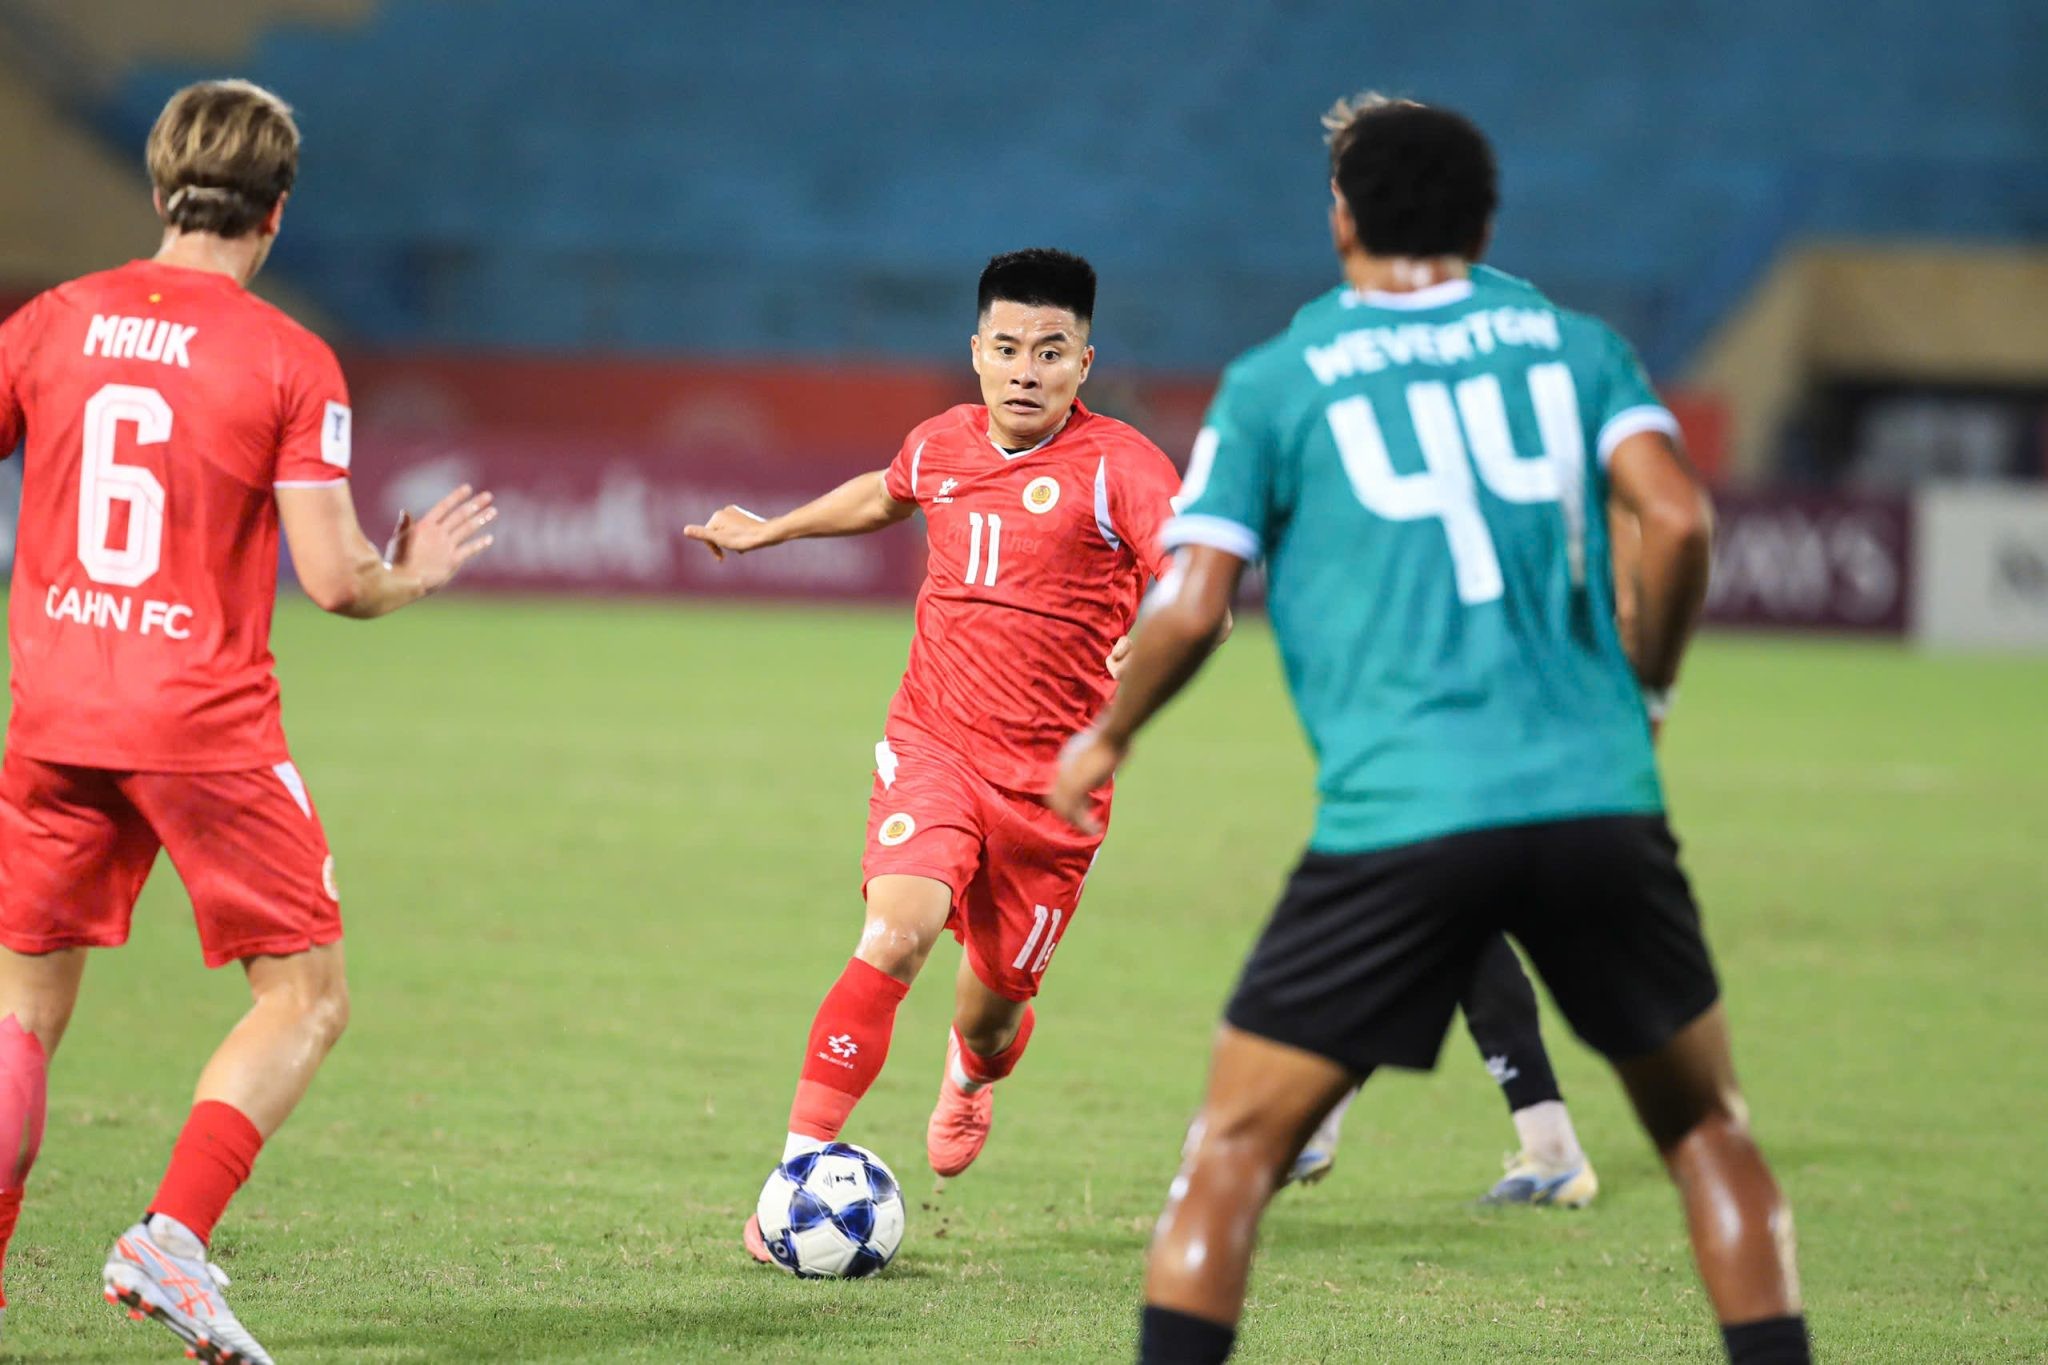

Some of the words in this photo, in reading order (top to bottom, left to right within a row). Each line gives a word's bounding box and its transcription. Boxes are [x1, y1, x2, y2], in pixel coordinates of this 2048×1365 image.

[84, 314, 198, 368] MAUK
[1304, 305, 1561, 386] WEVERTON
[78, 383, 174, 588] 6
[1326, 361, 1586, 606] 44
[965, 511, 1002, 586] 11
[139, 599, 194, 640] FC
[1012, 903, 1062, 973] 11
